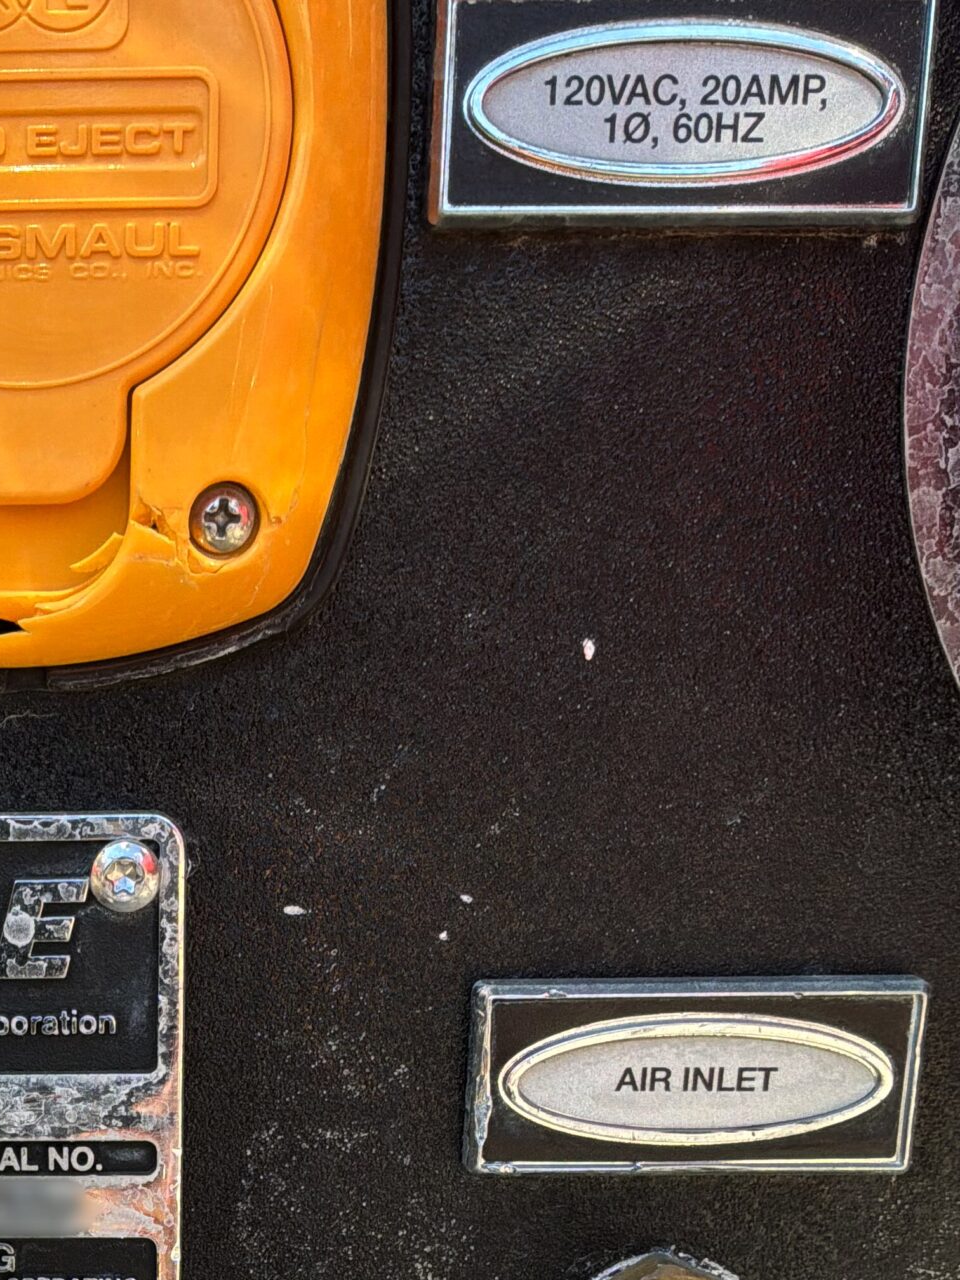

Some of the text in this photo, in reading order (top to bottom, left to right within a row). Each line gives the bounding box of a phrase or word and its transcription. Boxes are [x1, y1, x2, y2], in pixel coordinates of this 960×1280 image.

[544, 73, 828, 110] 120VAC, 20AMP,
[26, 122, 196, 158] EJECT
[672, 112, 764, 143] 60HZ
[144, 260, 202, 278] INC.
[615, 1067, 778, 1092] AIR INLET
[48, 1146, 103, 1172] NO.
